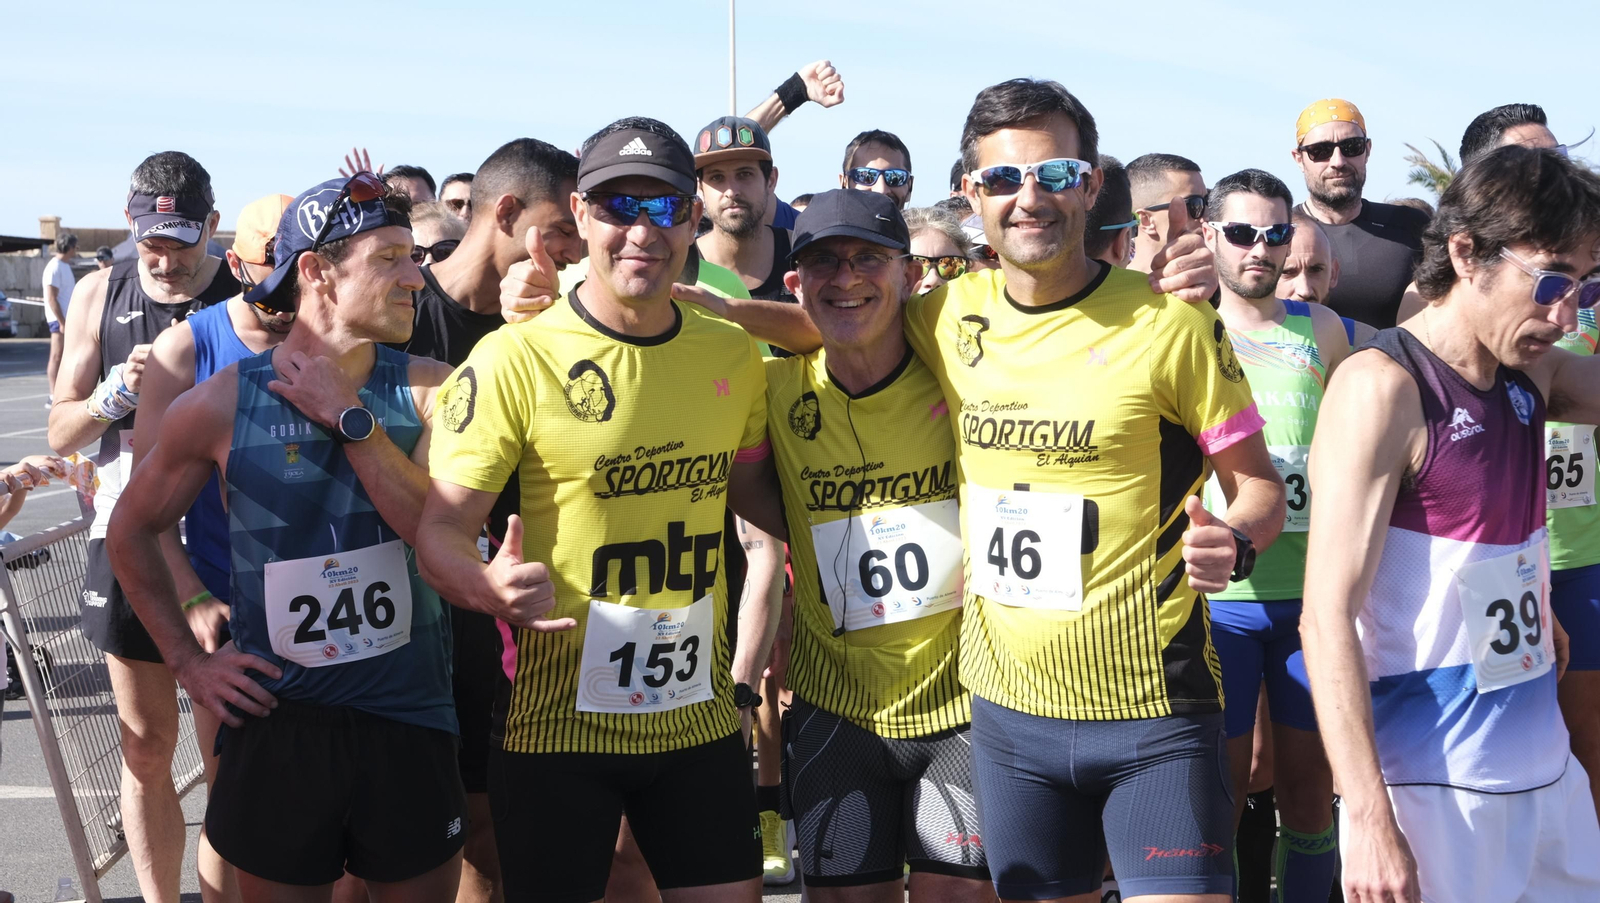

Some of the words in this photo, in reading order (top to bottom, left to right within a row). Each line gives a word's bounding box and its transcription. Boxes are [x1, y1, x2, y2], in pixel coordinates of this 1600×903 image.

[619, 148, 653, 156] adidas
[981, 400, 1029, 414] Deportivo
[270, 422, 312, 438] GOBIK
[962, 413, 1096, 452] SPORTGYM
[595, 454, 632, 471] Centro
[634, 440, 685, 460] Deportivo
[1036, 453, 1051, 467] El
[1053, 451, 1100, 468] Alquián
[800, 466, 831, 480] Centro
[833, 461, 885, 478] Deportivo
[1546, 452, 1584, 490] 65
[808, 460, 952, 511] SPORTGYM
[690, 489, 703, 503] El
[870, 523, 906, 535] 10km20
[987, 527, 1042, 580] 46
[322, 566, 359, 578] 10km20
[858, 542, 930, 598] 60
[288, 581, 396, 644] 246
[652, 621, 685, 630] 10km20
[609, 635, 700, 688] 153
